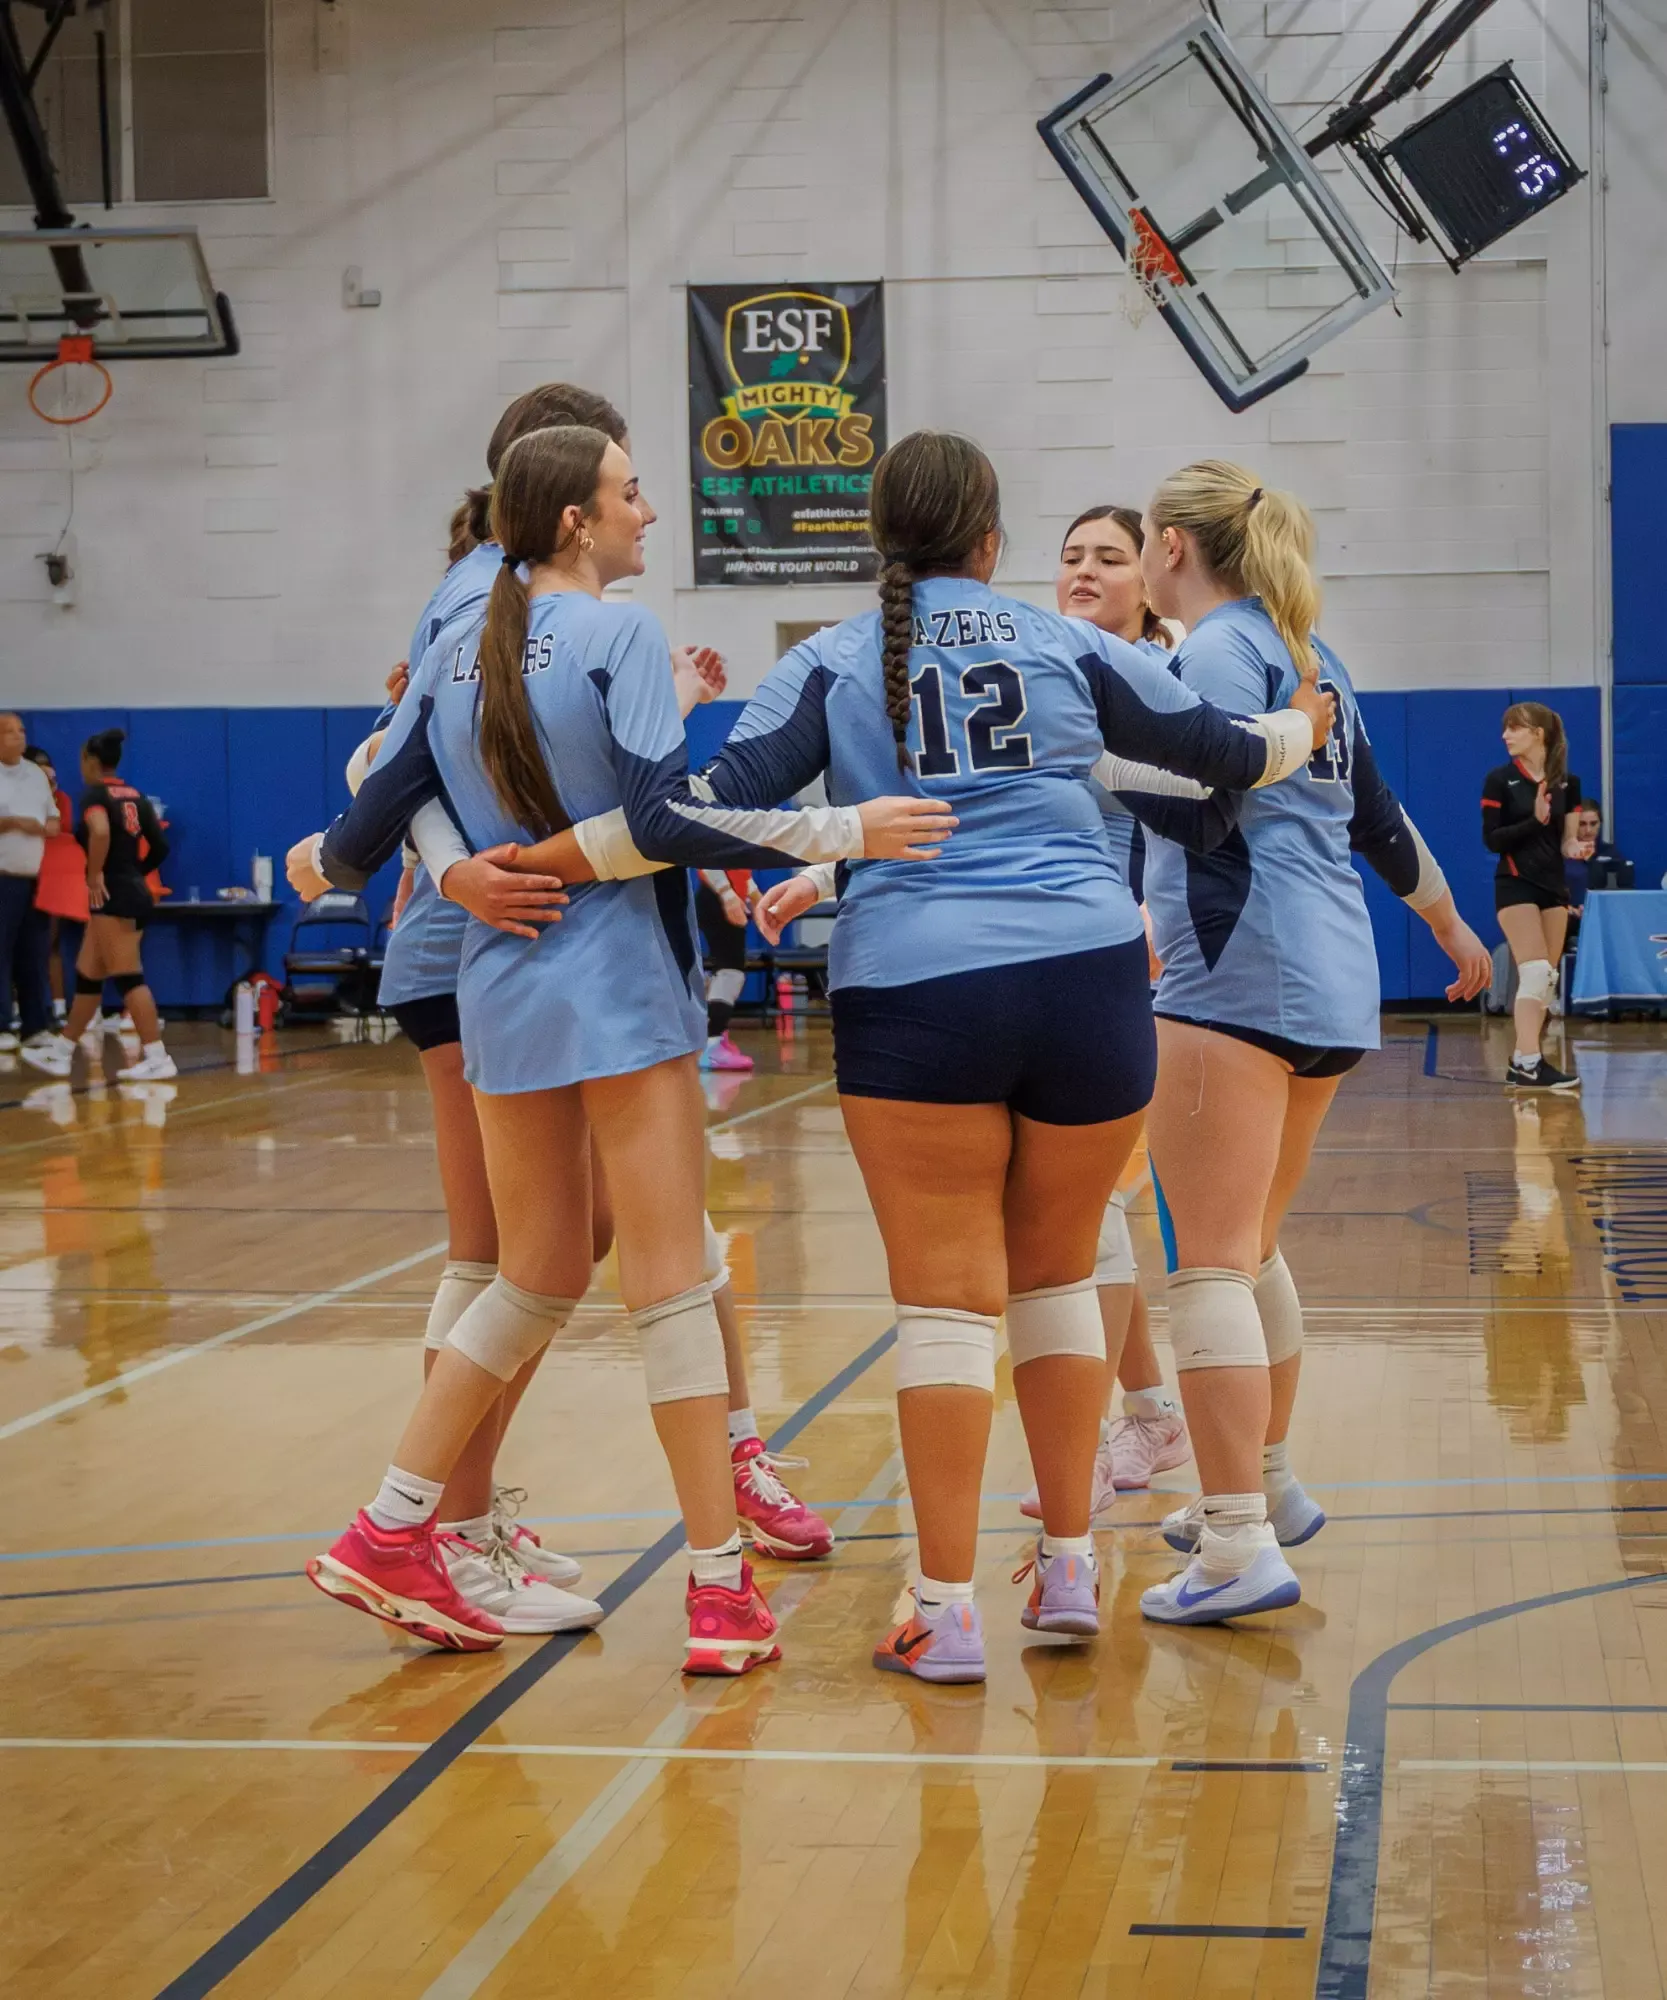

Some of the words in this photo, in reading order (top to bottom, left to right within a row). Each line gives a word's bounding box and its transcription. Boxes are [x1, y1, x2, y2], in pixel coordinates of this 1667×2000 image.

[742, 309, 833, 352] ESF
[741, 385, 838, 407] MIGHTY
[702, 413, 874, 470] OAKS
[702, 476, 745, 496] ESF
[751, 473, 873, 496] ATHLETICS
[792, 507, 872, 519] esfathletics.co
[725, 560, 777, 573] IMPROVE
[778, 560, 813, 572] YOUR
[814, 560, 859, 573] WORLD
[912, 609, 1018, 648] AZERS
[452, 632, 556, 684] LARS
[909, 659, 1034, 780] 12
